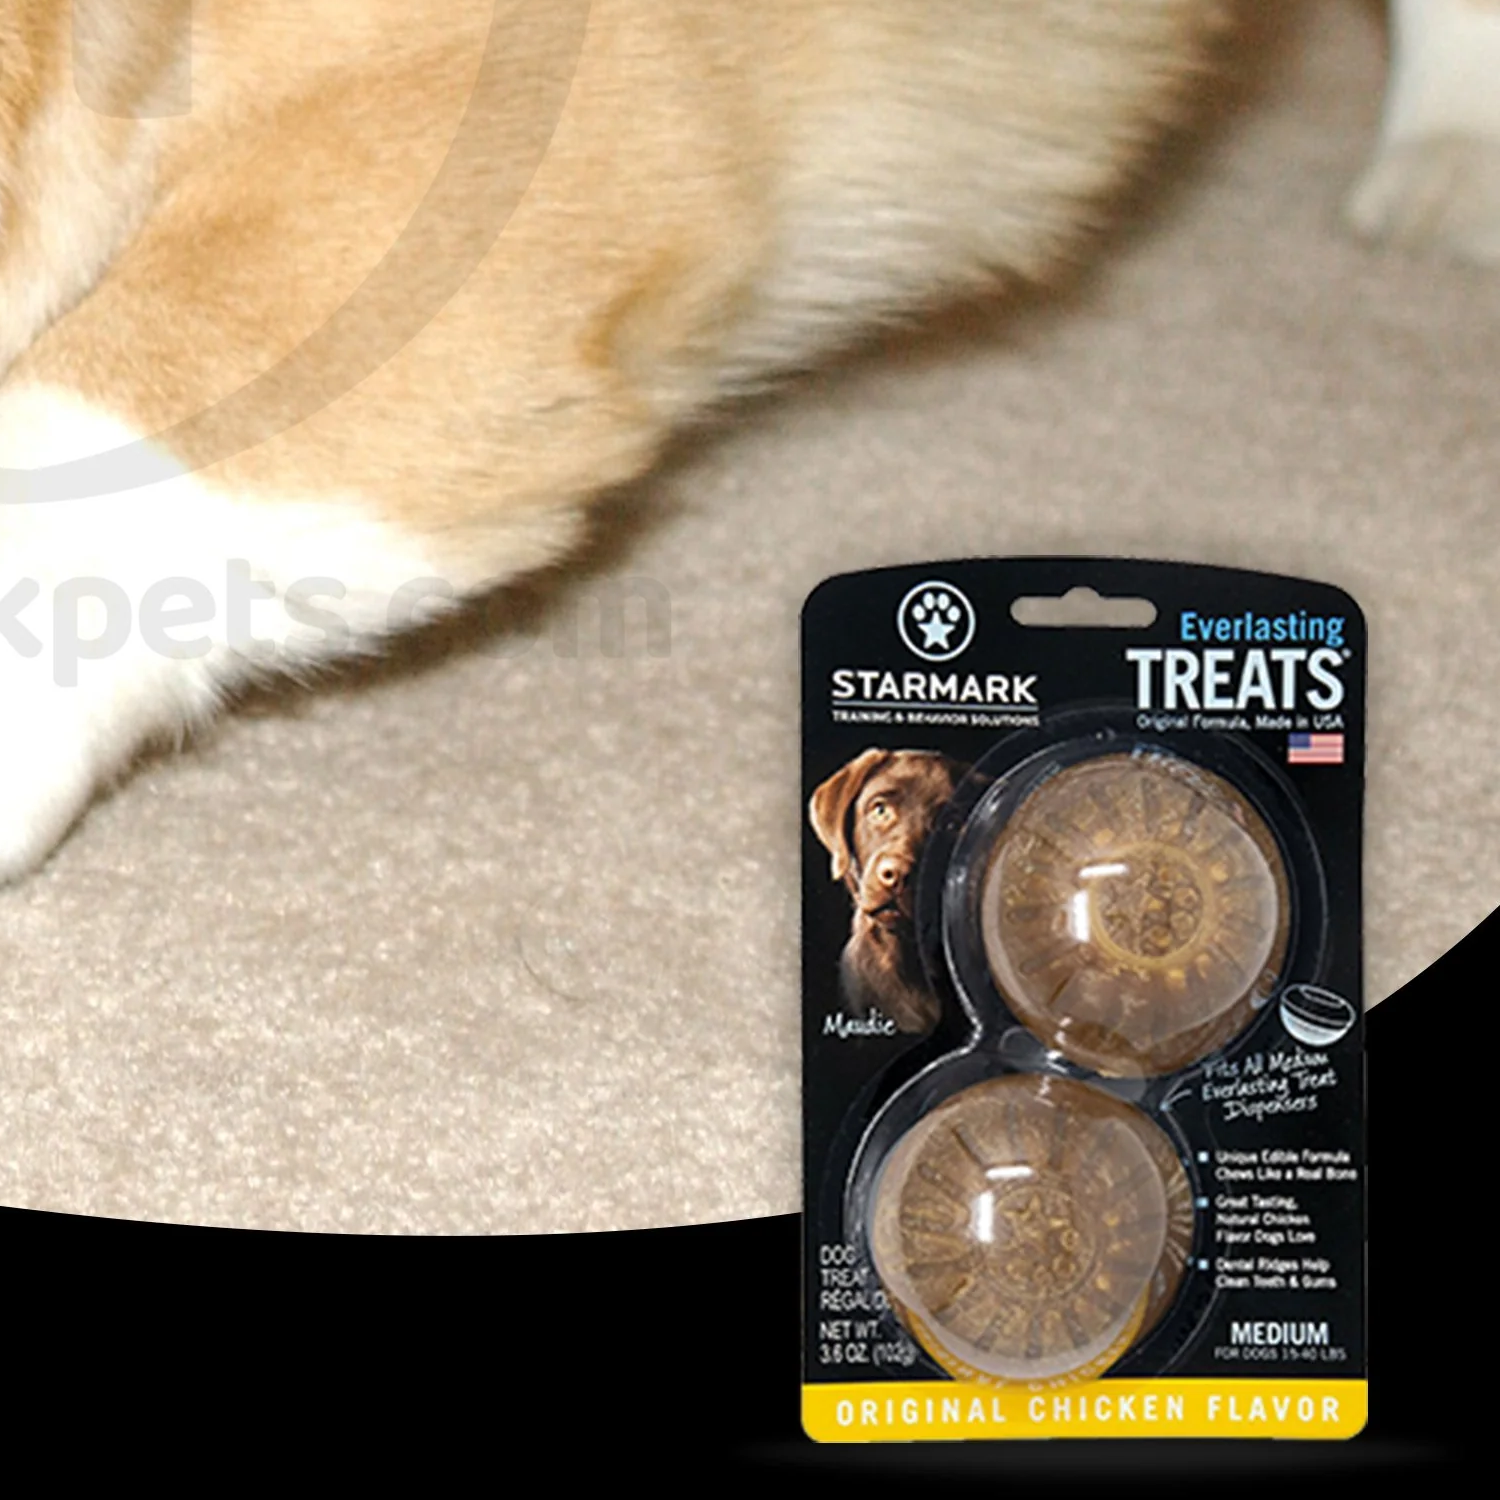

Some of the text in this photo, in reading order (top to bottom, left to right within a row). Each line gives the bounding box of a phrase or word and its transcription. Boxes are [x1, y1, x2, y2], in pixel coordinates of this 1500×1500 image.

[1180, 610, 1346, 648] Everlasting
[831, 669, 1038, 703] STARMARK
[1125, 647, 1345, 710] TREATS
[832, 710, 891, 724] TRAINING
[970, 713, 1040, 728] SOLUTIONS
[1136, 713, 1188, 732] Original
[1255, 714, 1292, 729] Made
[1312, 714, 1344, 729] USA
[1202, 1068, 1339, 1102] Everlasting Treat
[1302, 1148, 1350, 1164] Formula
[1215, 1212, 1311, 1225] Natural Chicken
[1215, 1229, 1251, 1243] Flavor
[1287, 1229, 1316, 1243] Love
[819, 1244, 857, 1266] DOG
[1302, 1257, 1330, 1273] Help
[819, 1268, 870, 1287] TREAT
[819, 1320, 851, 1340] NET
[1231, 1322, 1329, 1345] MEDIUM
[835, 1394, 1341, 1427] ORIGINAL CHICKEN FLAVOR
